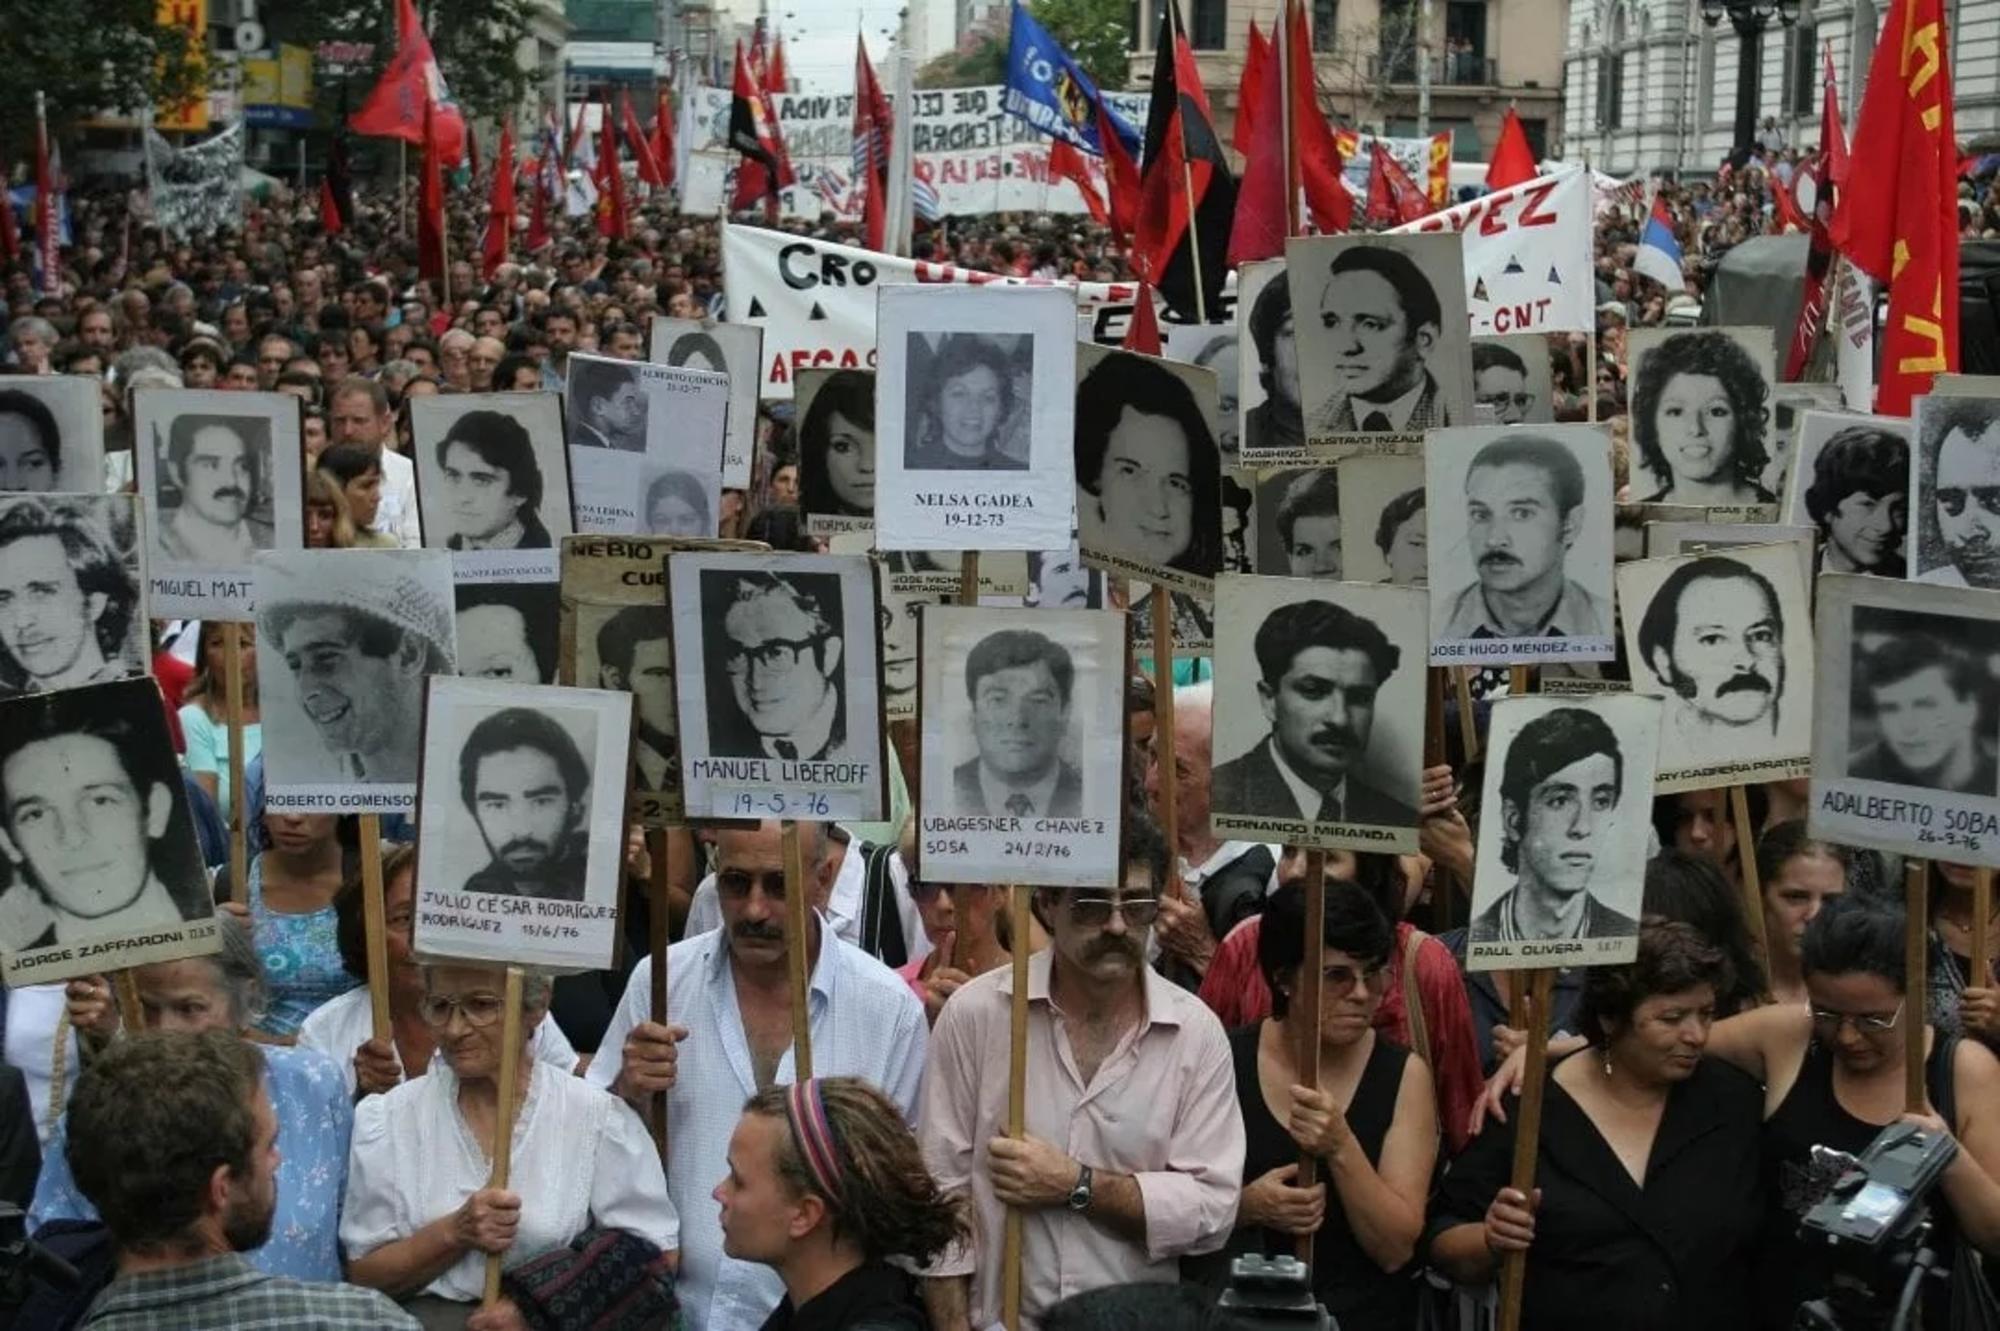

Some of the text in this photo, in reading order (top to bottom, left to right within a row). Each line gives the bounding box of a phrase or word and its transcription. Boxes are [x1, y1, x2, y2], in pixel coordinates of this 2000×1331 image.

[914, 493, 1034, 508] NELSA GADEA
[944, 513, 1006, 527] 19-12-73
[570, 540, 653, 560] NEBIO
[150, 579, 208, 597] MIGUEL
[1469, 643, 1509, 656] HUGO
[693, 760, 870, 784] MANUEL LIBEROFF
[266, 794, 336, 807] ROBERTO
[734, 791, 830, 815] 19-5-76
[1822, 791, 1999, 836] ADALBERTO SOBA
[923, 817, 1105, 834] UBAGESNER CHAVEZ
[1216, 817, 1308, 835] FERNANDO
[1313, 824, 1397, 842] MIRANDA
[926, 839, 1072, 858] SOSA 24/2/76
[423, 891, 471, 910] JULIO
[9, 949, 74, 971] JORGE
[78, 931, 184, 958] ZAFFARONI
[1520, 943, 1583, 956] OLIVERA
